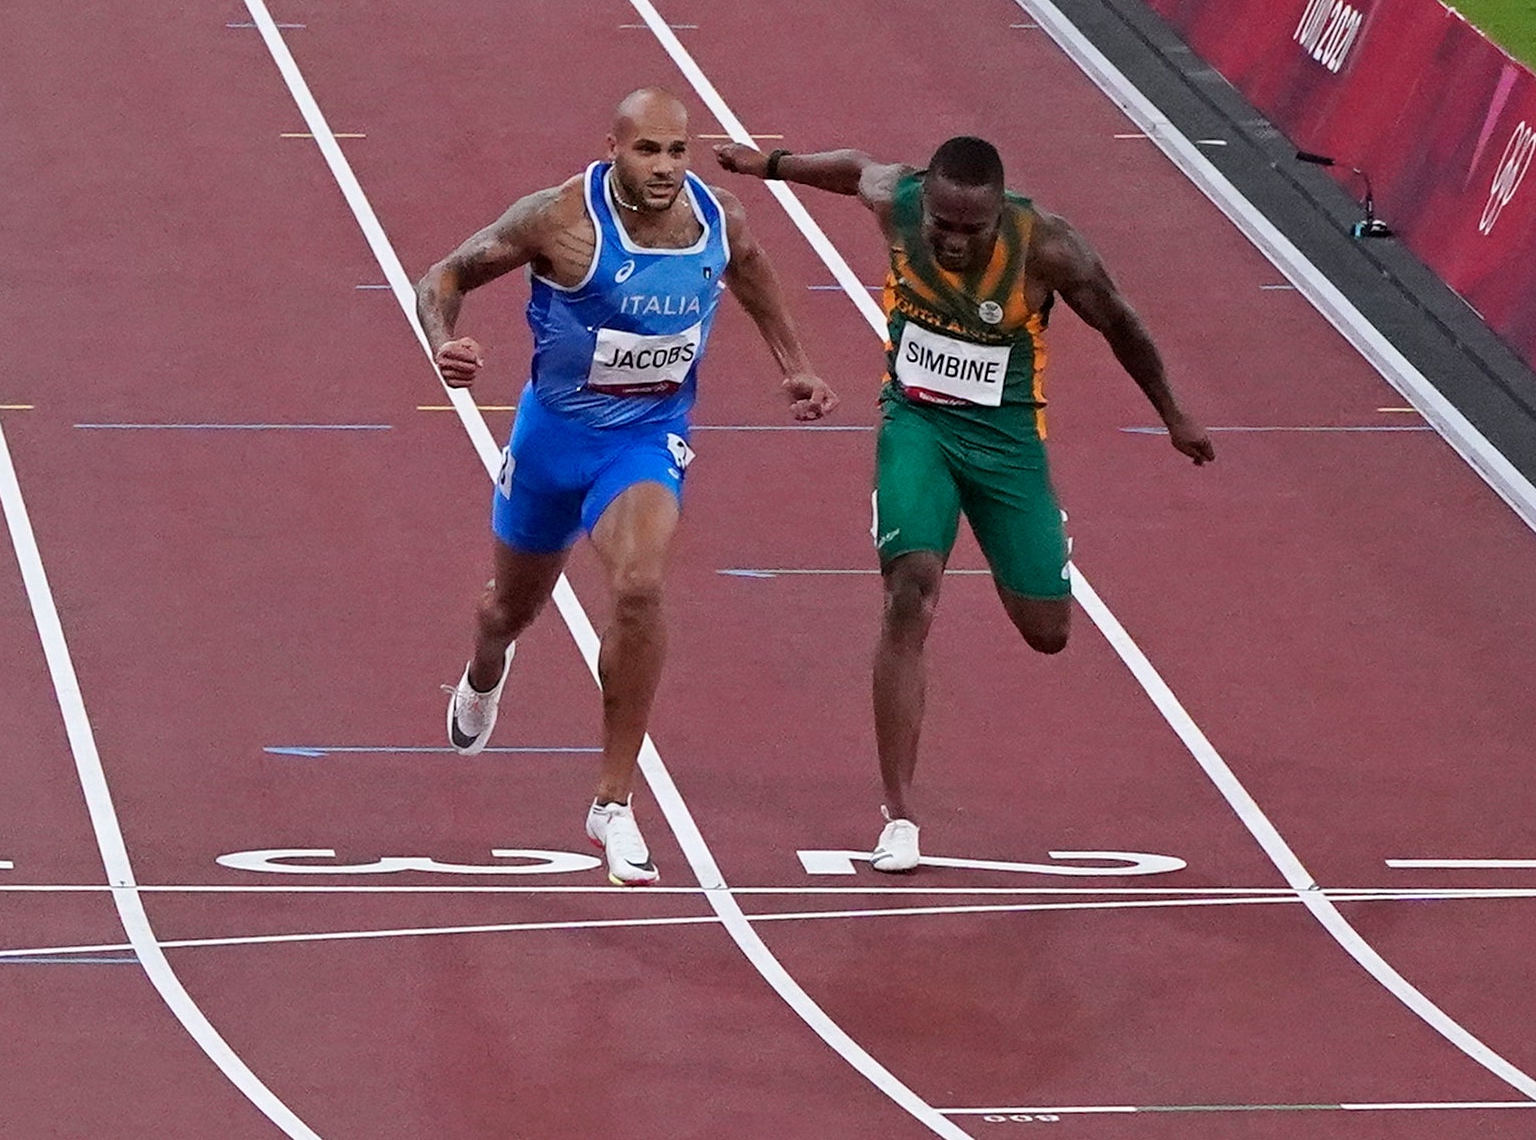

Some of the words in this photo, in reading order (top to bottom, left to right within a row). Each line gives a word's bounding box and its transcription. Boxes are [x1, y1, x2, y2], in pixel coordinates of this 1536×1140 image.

[620, 295, 701, 316] ITALIA
[604, 342, 696, 369] JACOBS
[906, 341, 1001, 383] SIMBINE
